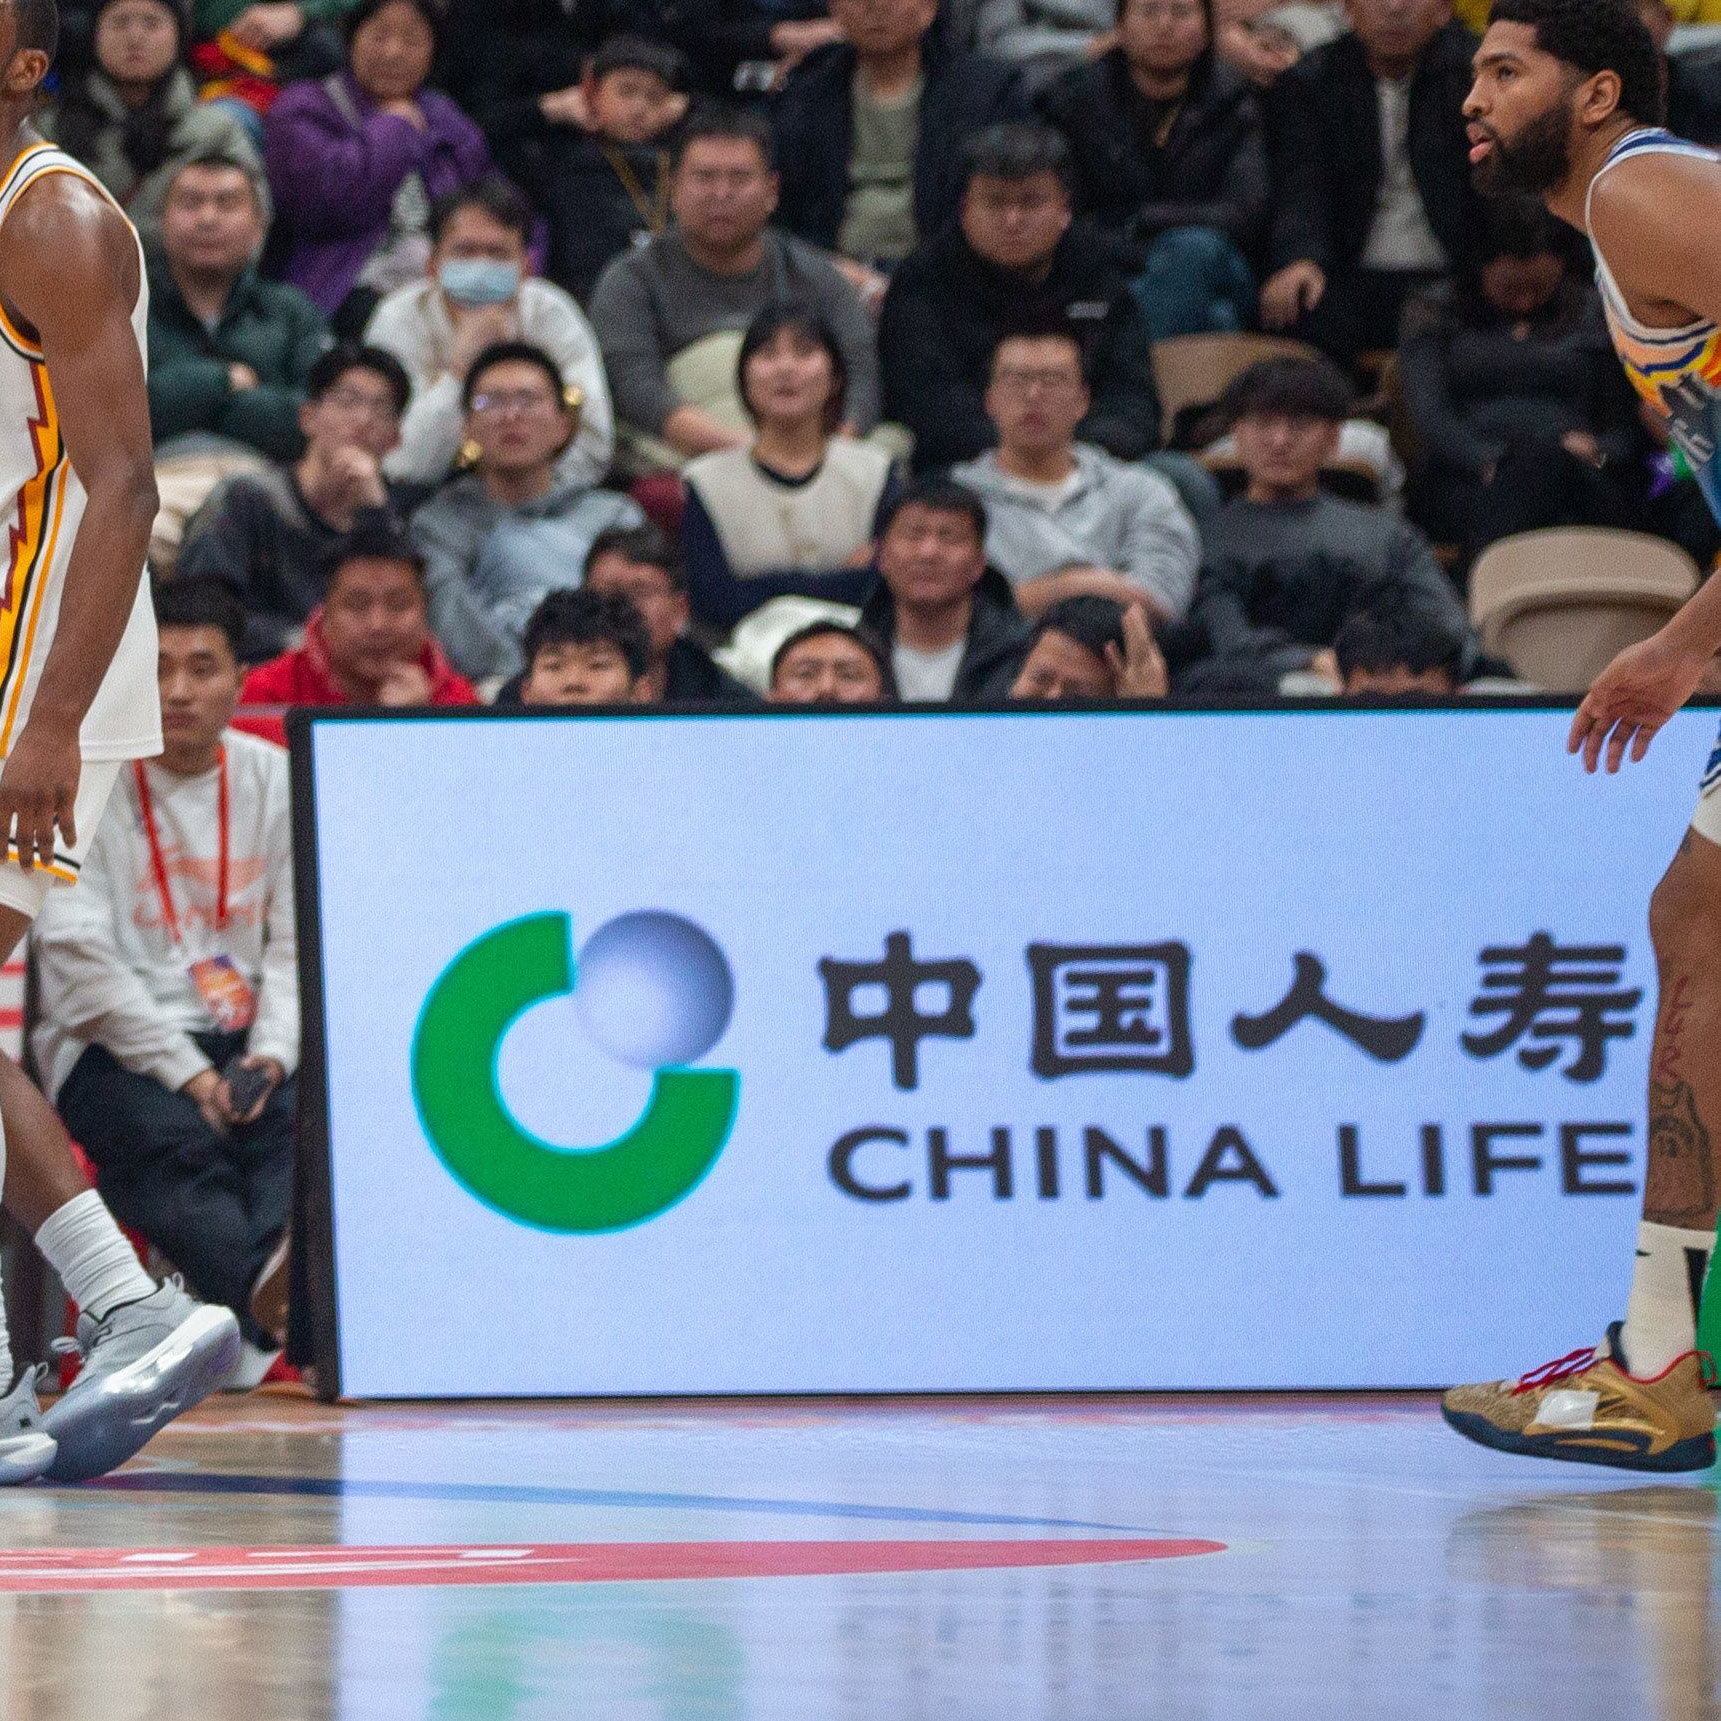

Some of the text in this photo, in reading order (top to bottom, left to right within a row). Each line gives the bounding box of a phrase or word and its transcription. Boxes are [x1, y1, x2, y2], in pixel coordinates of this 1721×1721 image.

[816, 929, 1645, 1090] 中国人寿
[827, 1121, 1639, 1203] CHINA LIFE
